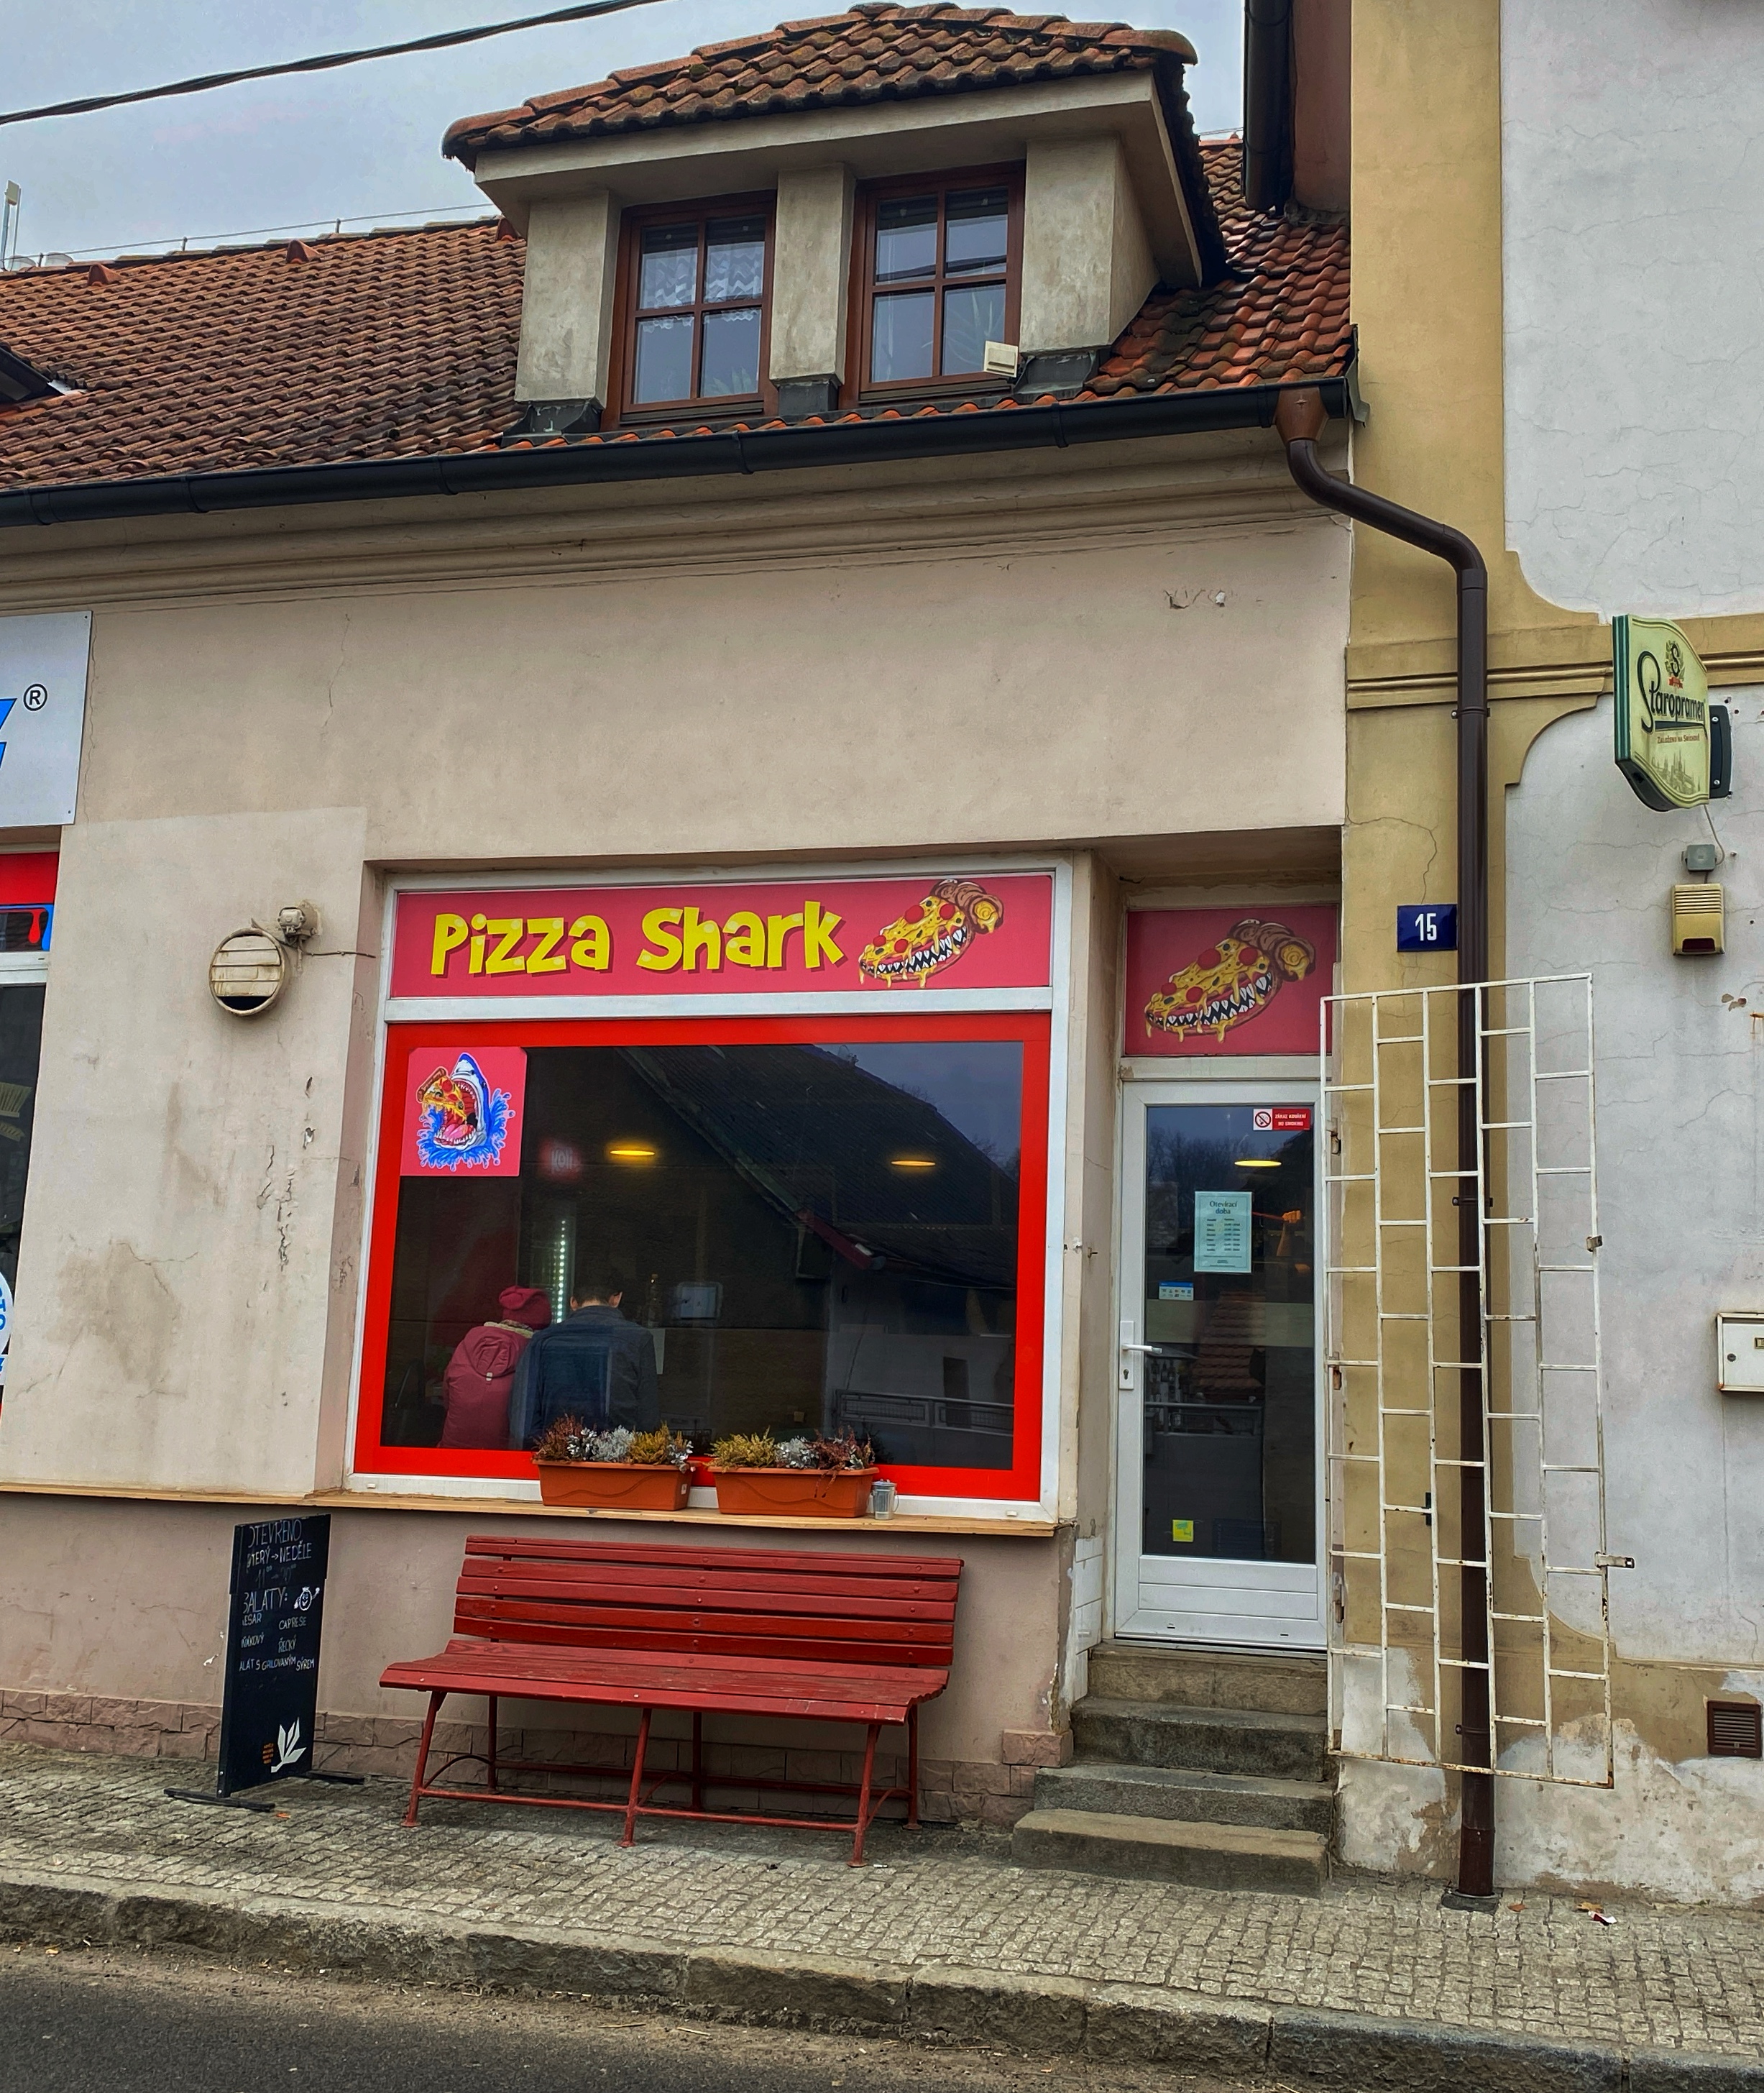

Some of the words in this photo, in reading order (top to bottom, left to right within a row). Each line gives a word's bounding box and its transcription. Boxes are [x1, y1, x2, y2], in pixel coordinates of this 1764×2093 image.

[1637, 650, 1706, 734] Staropramen
[1415, 912, 1437, 941] 15
[431, 913, 611, 975] Pizza
[636, 900, 845, 971] Shark
[242, 1613, 262, 1626] ESAR
[278, 1616, 307, 1631] CAPRESE
[240, 1631, 265, 1649] ŇÁKOVÝ
[239, 1657, 255, 1672] ALÁT
